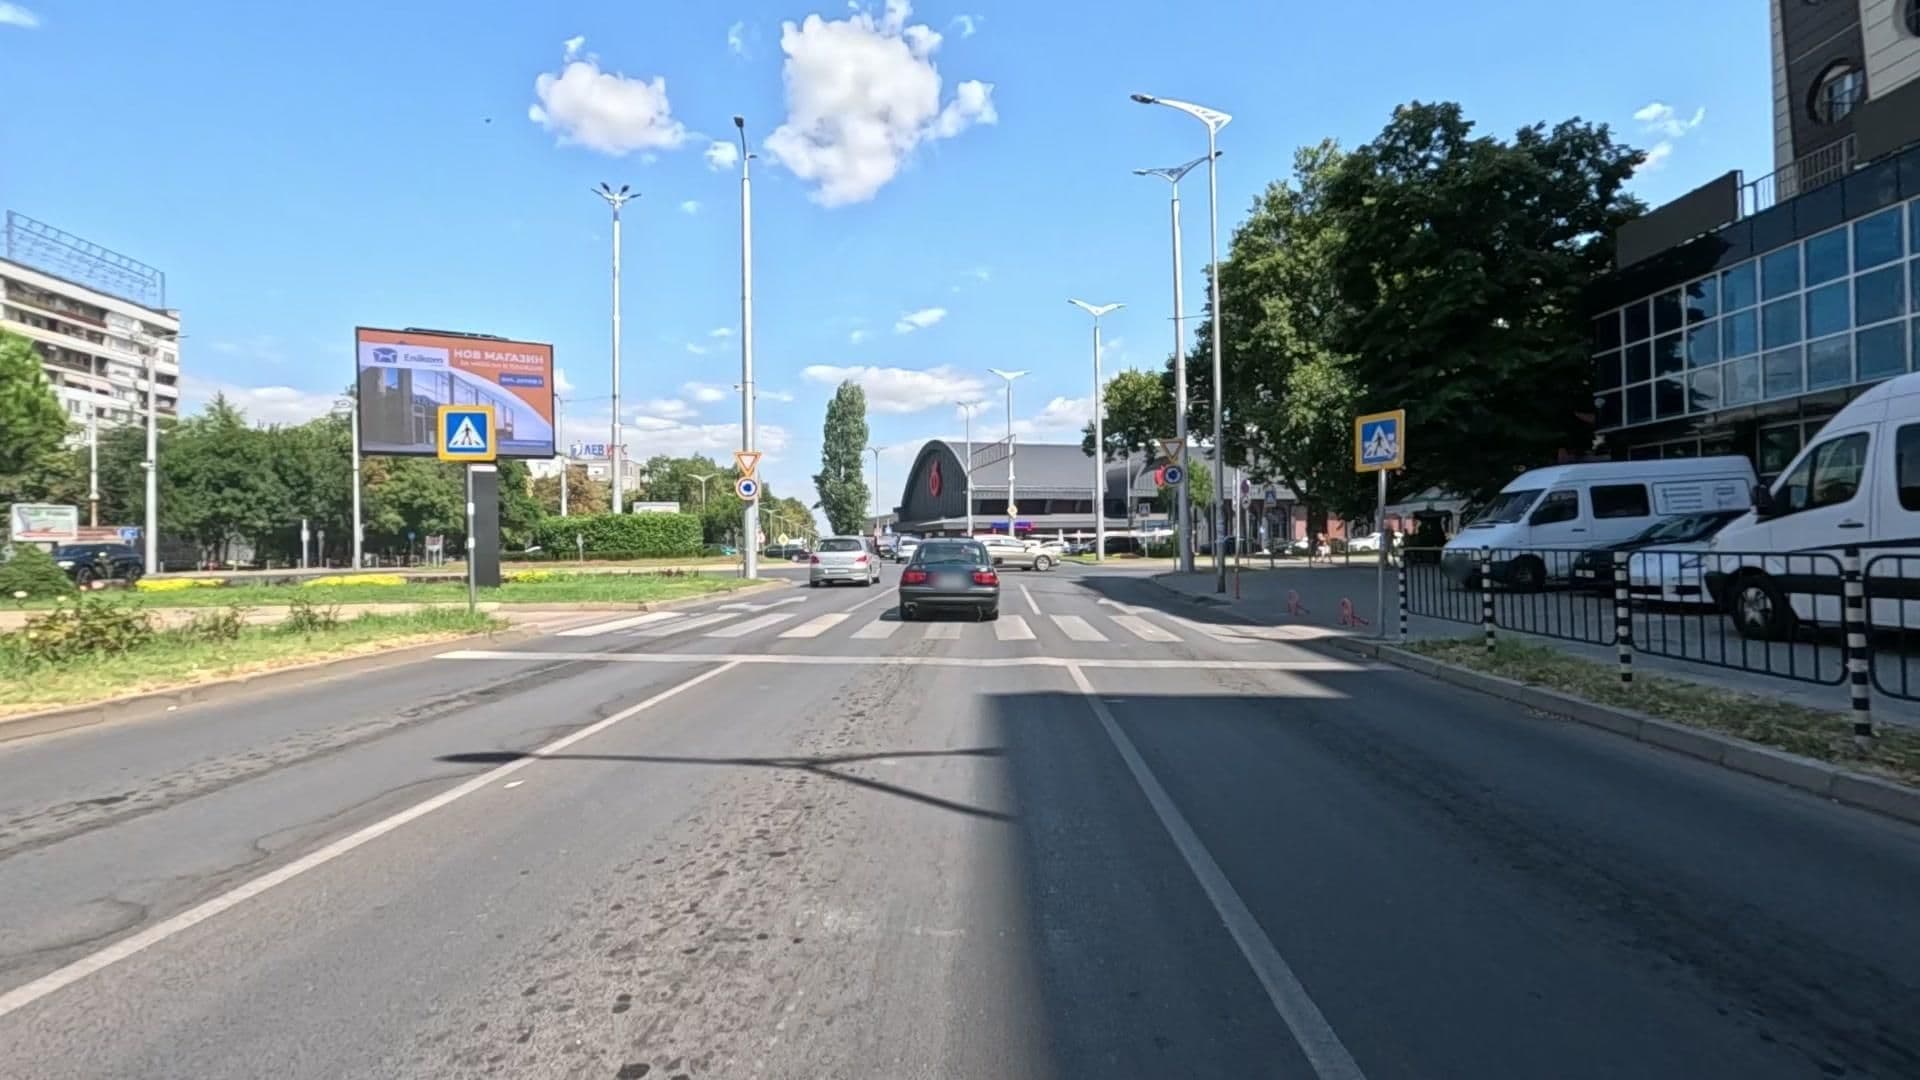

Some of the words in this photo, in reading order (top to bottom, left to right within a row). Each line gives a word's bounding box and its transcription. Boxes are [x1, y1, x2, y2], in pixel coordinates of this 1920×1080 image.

[454, 349, 481, 360] НОВ
[484, 351, 544, 364] МАГАЗИН
[606, 443, 629, 457] ИС
